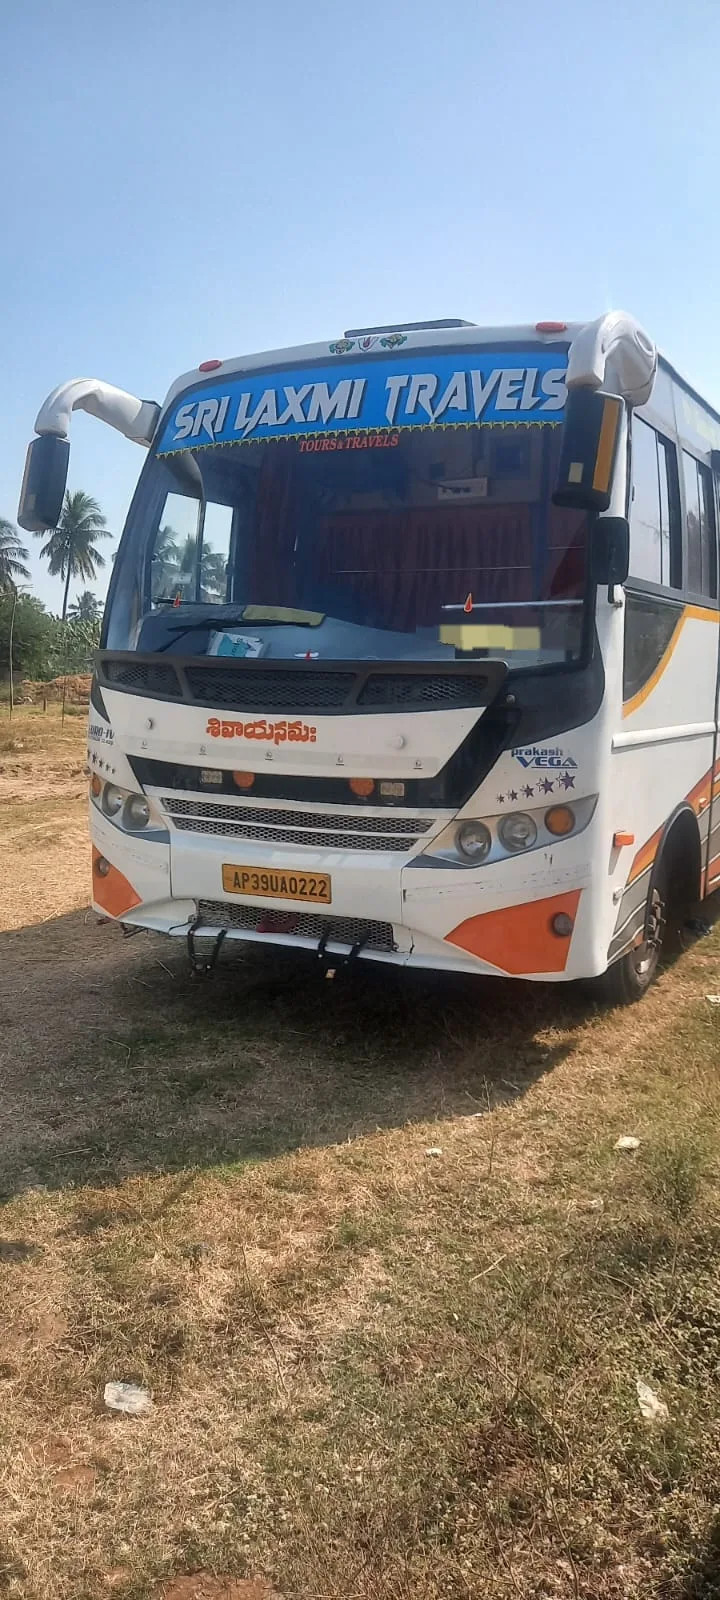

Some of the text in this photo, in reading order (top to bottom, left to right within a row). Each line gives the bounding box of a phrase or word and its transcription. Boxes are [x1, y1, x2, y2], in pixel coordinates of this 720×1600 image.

[173, 367, 568, 441] SRI LAXMI TRAVELS
[299, 438, 337, 453] TOURS
[345, 434, 399, 449] TRAVELS
[511, 747, 563, 758] prakash
[516, 757, 578, 768] VEGA
[233, 871, 328, 898] AP39UA0222
